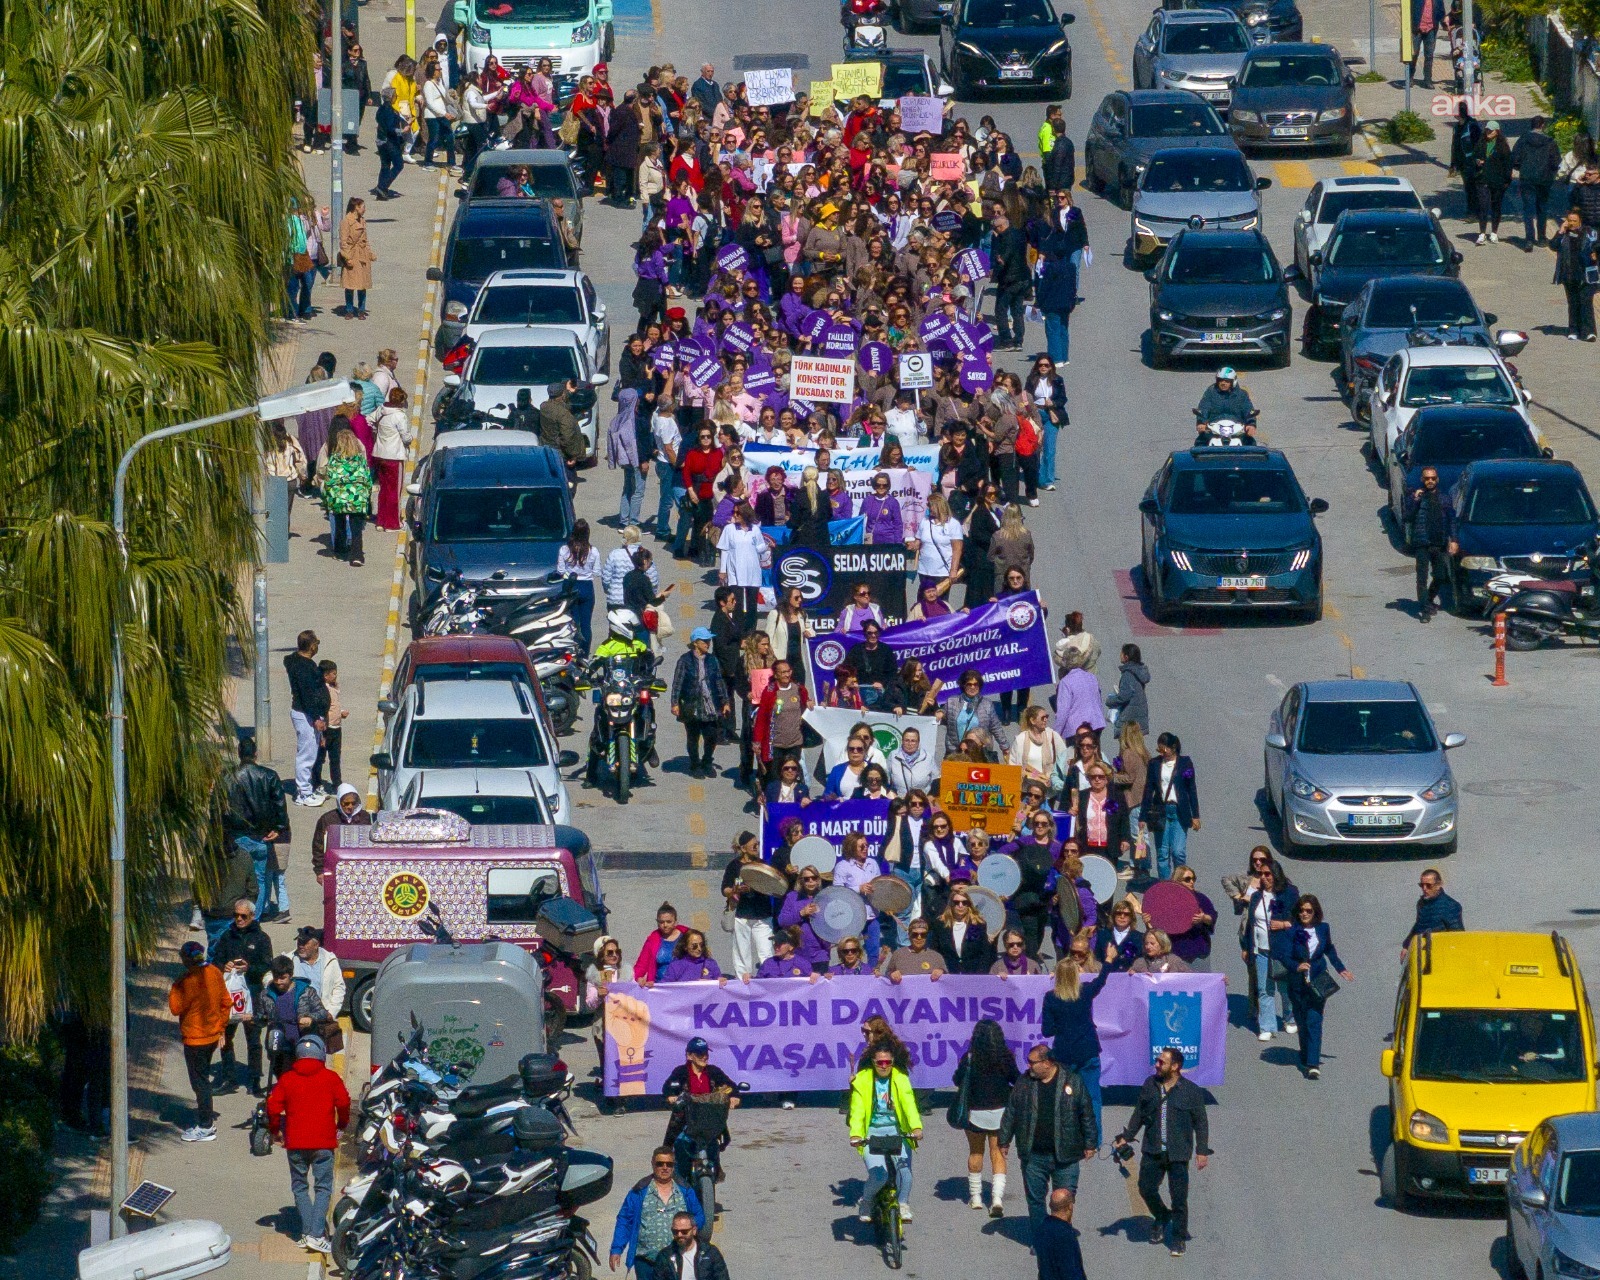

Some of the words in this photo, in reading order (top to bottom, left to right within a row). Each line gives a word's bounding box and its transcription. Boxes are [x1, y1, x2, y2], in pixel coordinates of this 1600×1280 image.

[811, 316, 827, 337] SEVGİ
[924, 318, 941, 330] İTAAT
[794, 360, 813, 371] TÜRK
[815, 362, 852, 375] KADINLAR
[870, 347, 881, 372] ADALET
[797, 374, 828, 385] KONSEYİ
[830, 376, 847, 387] DER.
[833, 554, 868, 572] SELDA
[869, 553, 905, 571] SUCAR
[1222, 578, 1232, 586] 09
[1234, 578, 1249, 586] ASA
[1250, 578, 1264, 586] 760
[892, 643, 937, 661] YECEK
[938, 628, 1002, 653] SÖZÜMÜZ,
[929, 647, 992, 672] GÜCÜMÜZ
[945, 791, 1014, 808] ATLASFOLK
[809, 822, 818, 836] 8
[821, 820, 861, 837] MART
[863, 816, 888, 836] DÜN
[1354, 815, 1364, 824] 06
[1387, 815, 1401, 824] 951
[387, 875, 424, 892] KAHVE
[693, 1000, 818, 1030] KADIN
[1475, 1169, 1489, 1180] 09
[1493, 1169, 1500, 1180] T
